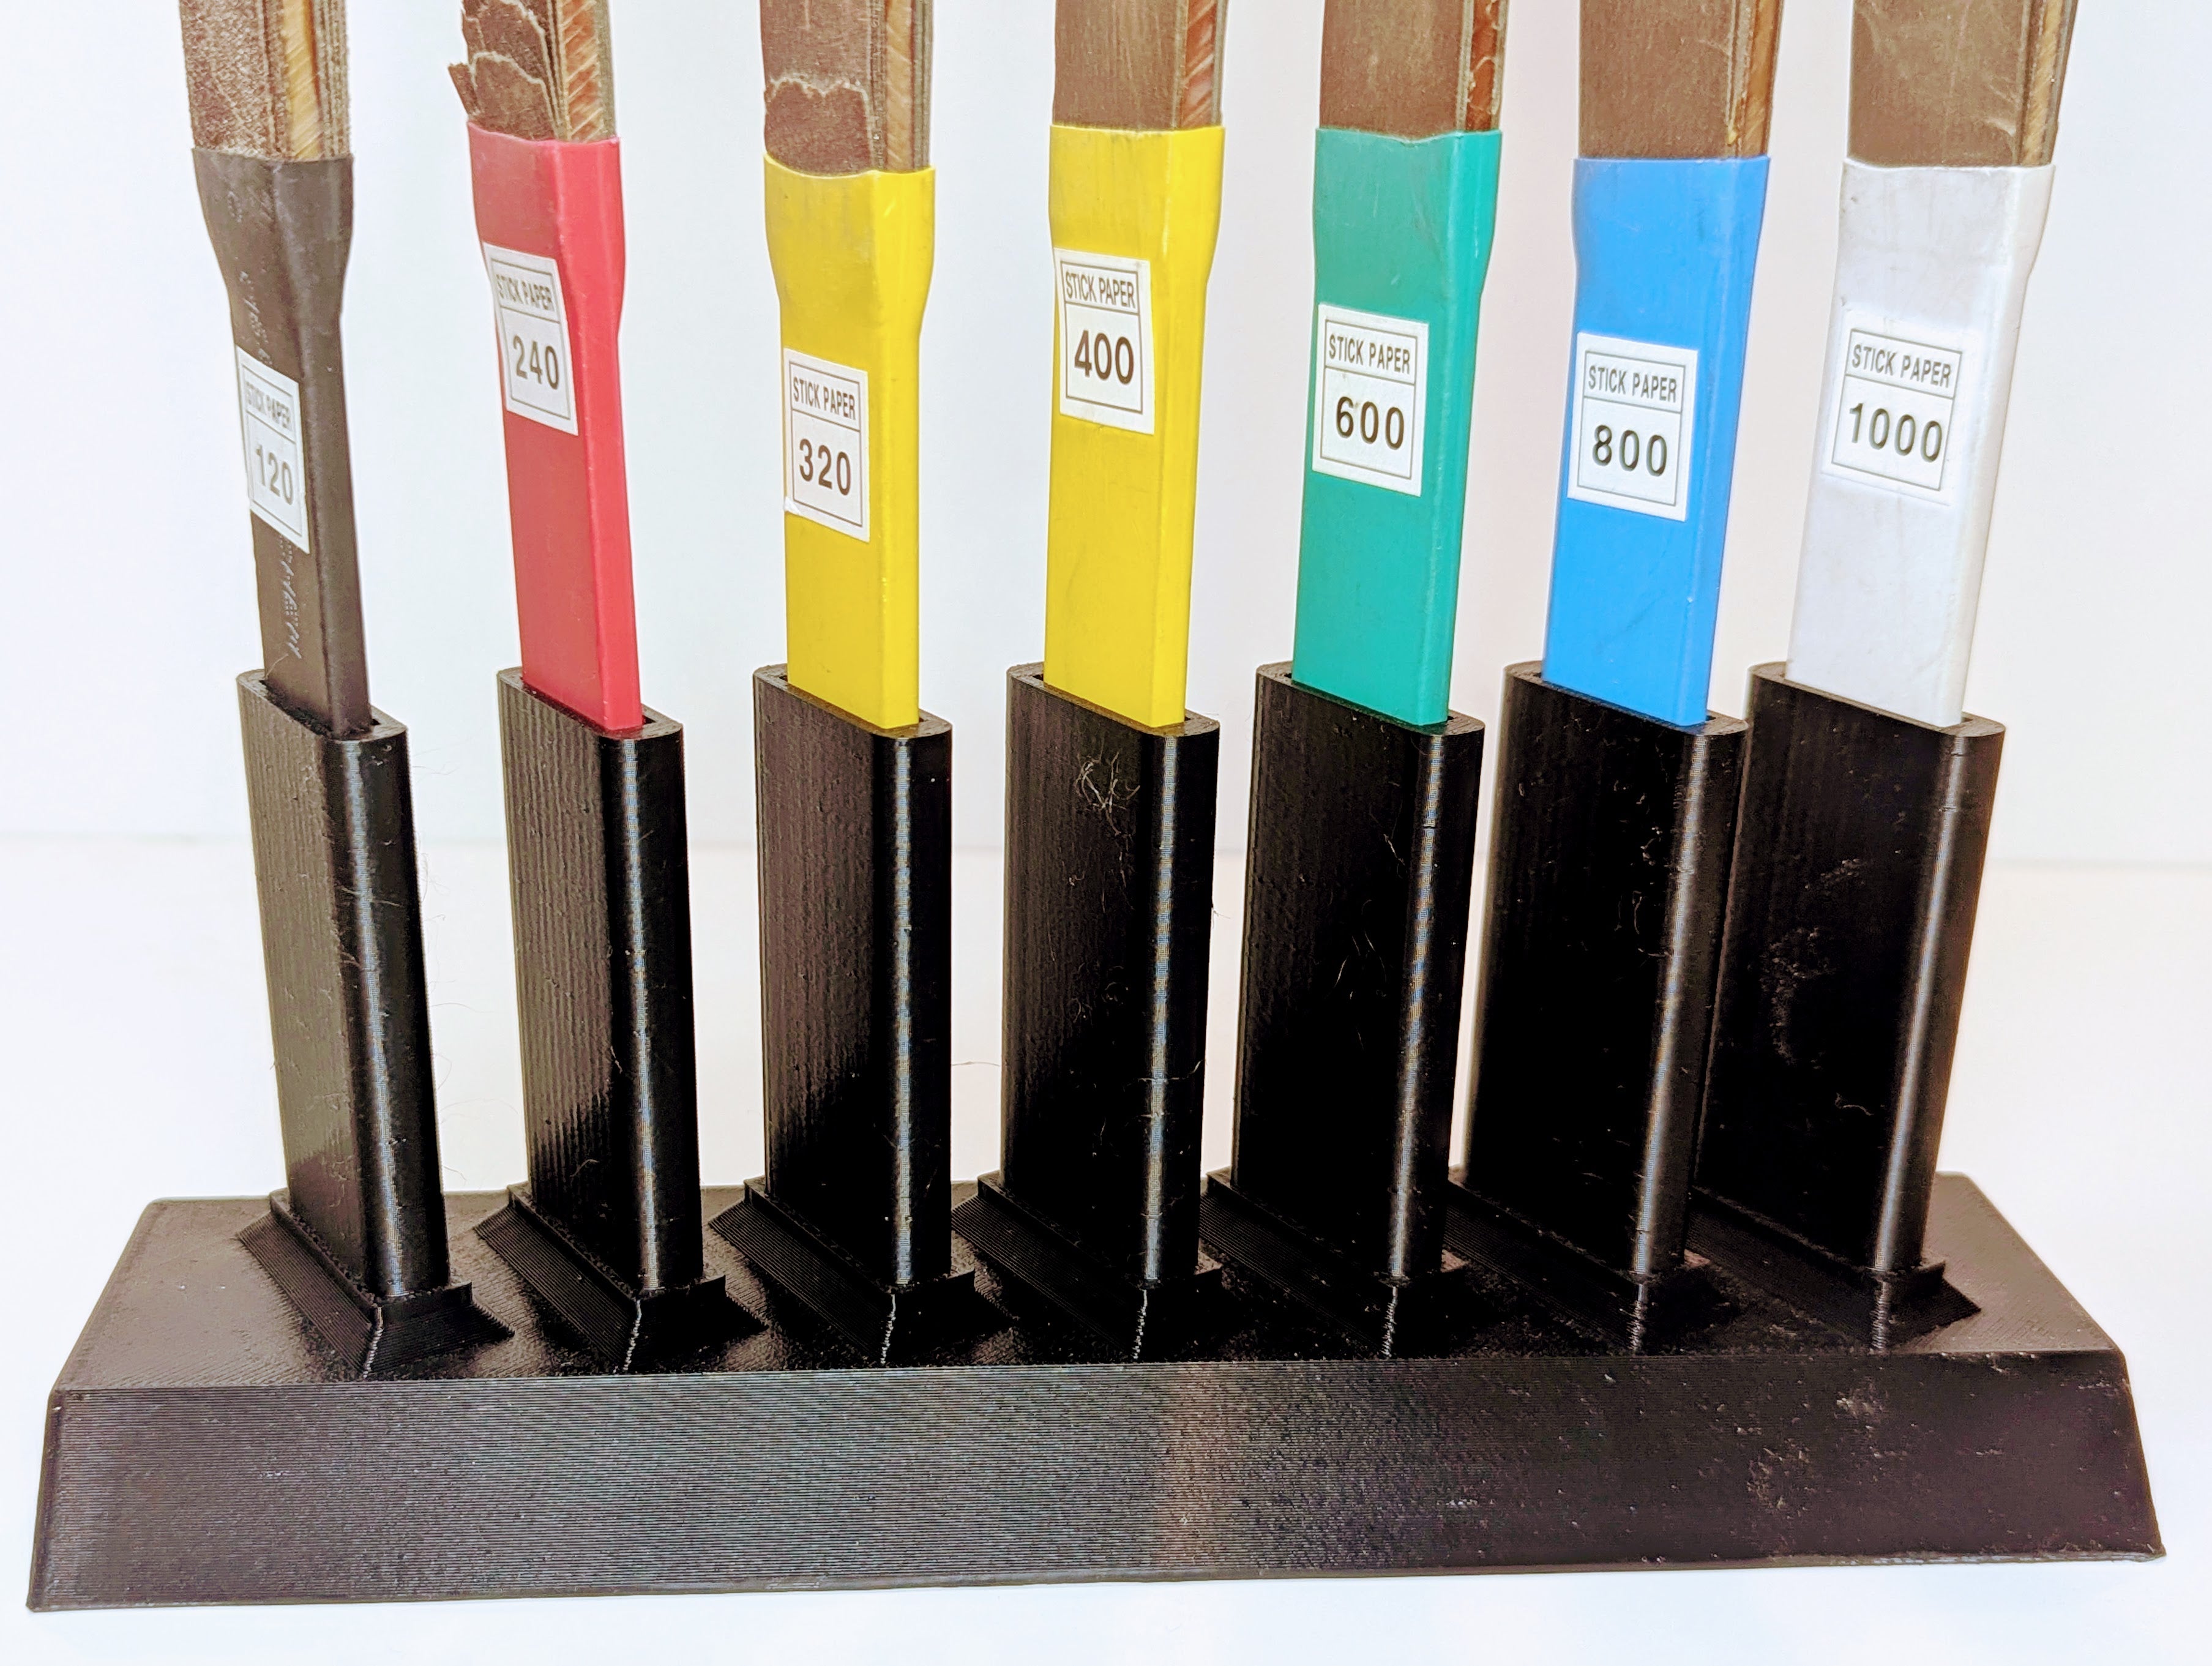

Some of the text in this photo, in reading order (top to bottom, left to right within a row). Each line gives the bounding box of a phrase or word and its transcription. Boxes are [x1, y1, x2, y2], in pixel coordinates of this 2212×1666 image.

[496, 274, 555, 312] STICK PAPER
[1065, 271, 1135, 309] STICK PAPER
[512, 334, 559, 390] 240
[1074, 329, 1134, 386] 400
[1329, 334, 1411, 375] STICK PAPER
[1851, 344, 1952, 389] STICK PAPER
[245, 381, 294, 432] STICK PAPER
[793, 376, 856, 420] STICK PAPER
[1588, 365, 1678, 403] STICK PAPER
[1336, 396, 1405, 450] 600
[1849, 402, 1943, 463] 1000
[255, 444, 294, 506] 120
[799, 438, 851, 496] 320
[1592, 424, 1668, 477] 800
